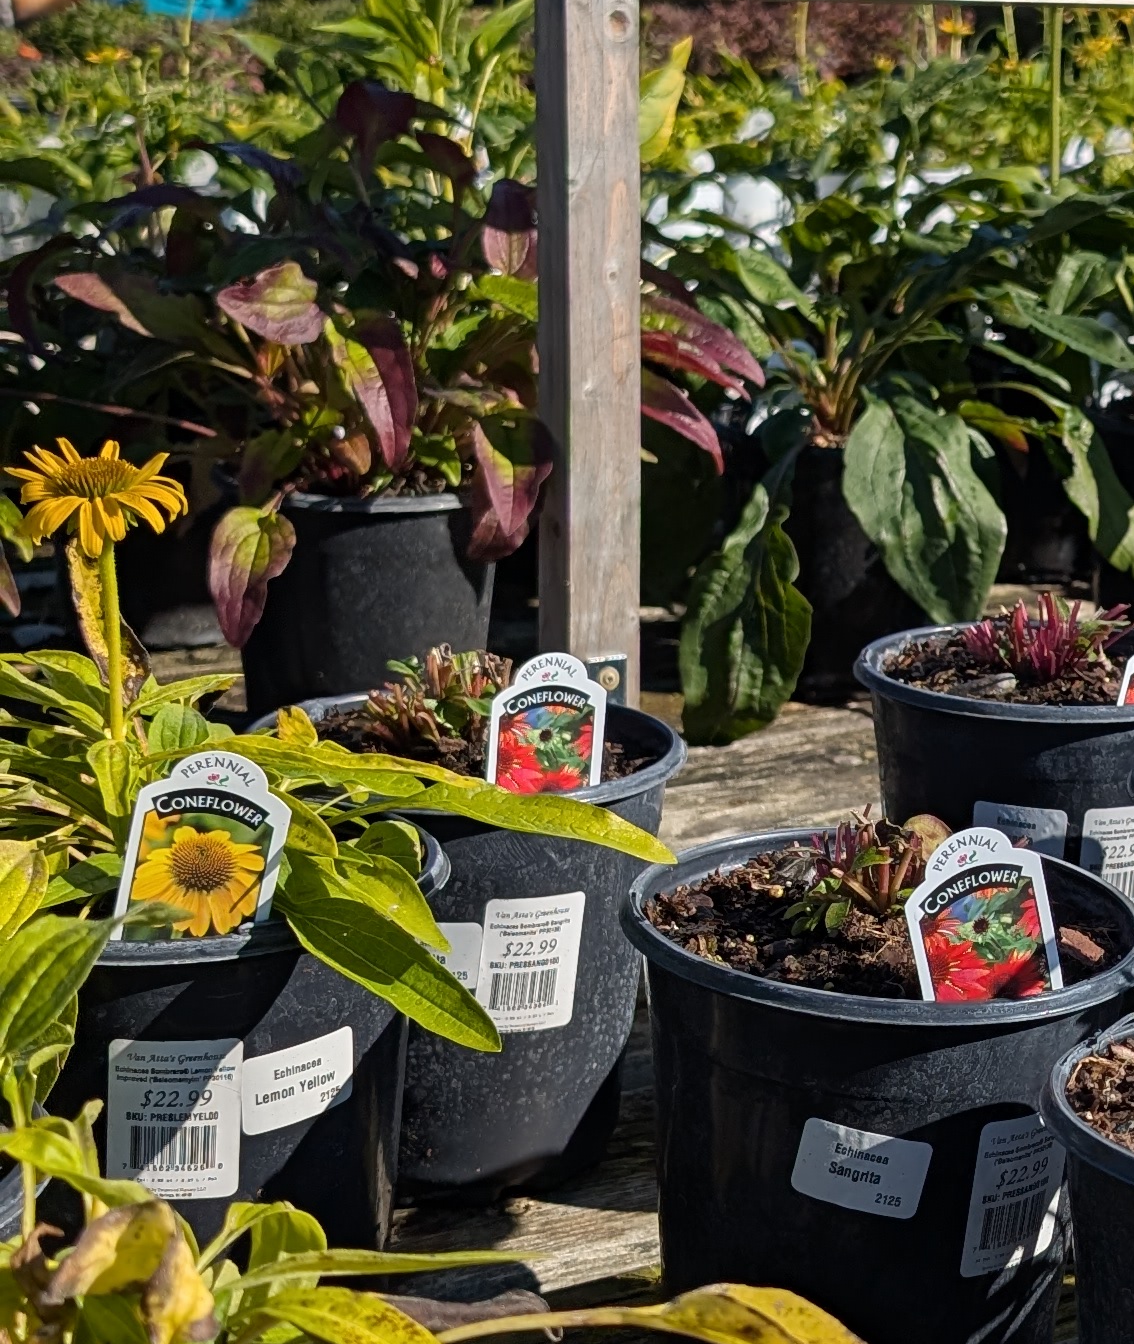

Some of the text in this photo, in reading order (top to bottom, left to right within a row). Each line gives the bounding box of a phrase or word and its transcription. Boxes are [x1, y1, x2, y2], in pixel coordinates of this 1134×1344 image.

[521, 656, 578, 682] PERENNIAL
[506, 690, 587, 715] CONEFLOWER
[180, 756, 257, 788] PERENNIAL
[156, 795, 264, 827] CONEFLOWER
[932, 834, 999, 872] PERENNIAL
[924, 869, 1019, 914] CONEFLOWER
[502, 938, 558, 959] $22.99
[126, 1052, 146, 1062] Van
[274, 1057, 322, 1081] Echinacea
[141, 1089, 213, 1110] $22.99
[255, 1070, 336, 1106] Lemon Yellow
[320, 1084, 342, 1103] 2125
[125, 1111, 148, 1122] SKU:
[834, 1142, 890, 1166] Echinacea
[828, 1161, 882, 1186] Sangrita
[996, 1156, 1049, 1190] $22.99
[874, 1193, 902, 1208] 2125
